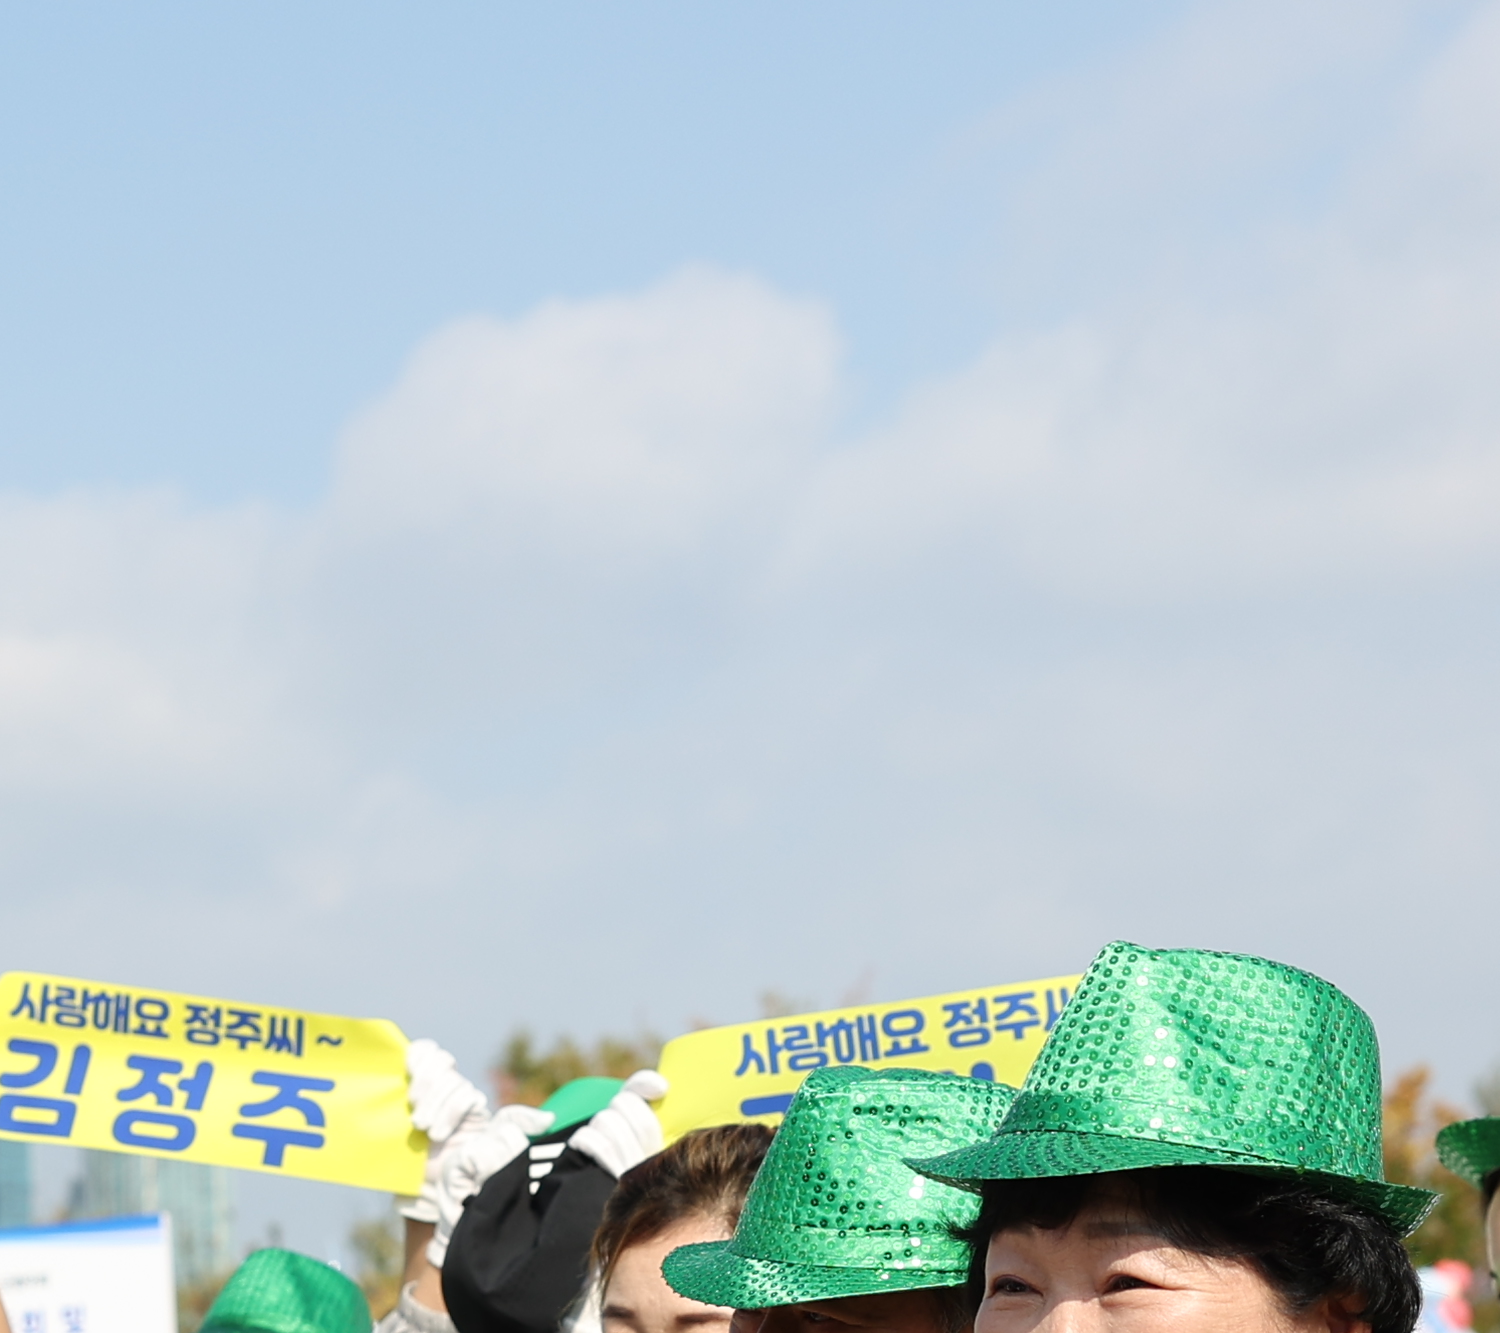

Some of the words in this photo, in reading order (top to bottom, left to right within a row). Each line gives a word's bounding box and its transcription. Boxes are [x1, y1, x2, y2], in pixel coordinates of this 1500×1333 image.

[10, 981, 170, 1039] 사랑해요
[183, 1002, 305, 1057] 정주씨
[735, 1008, 930, 1077] 사랑해요
